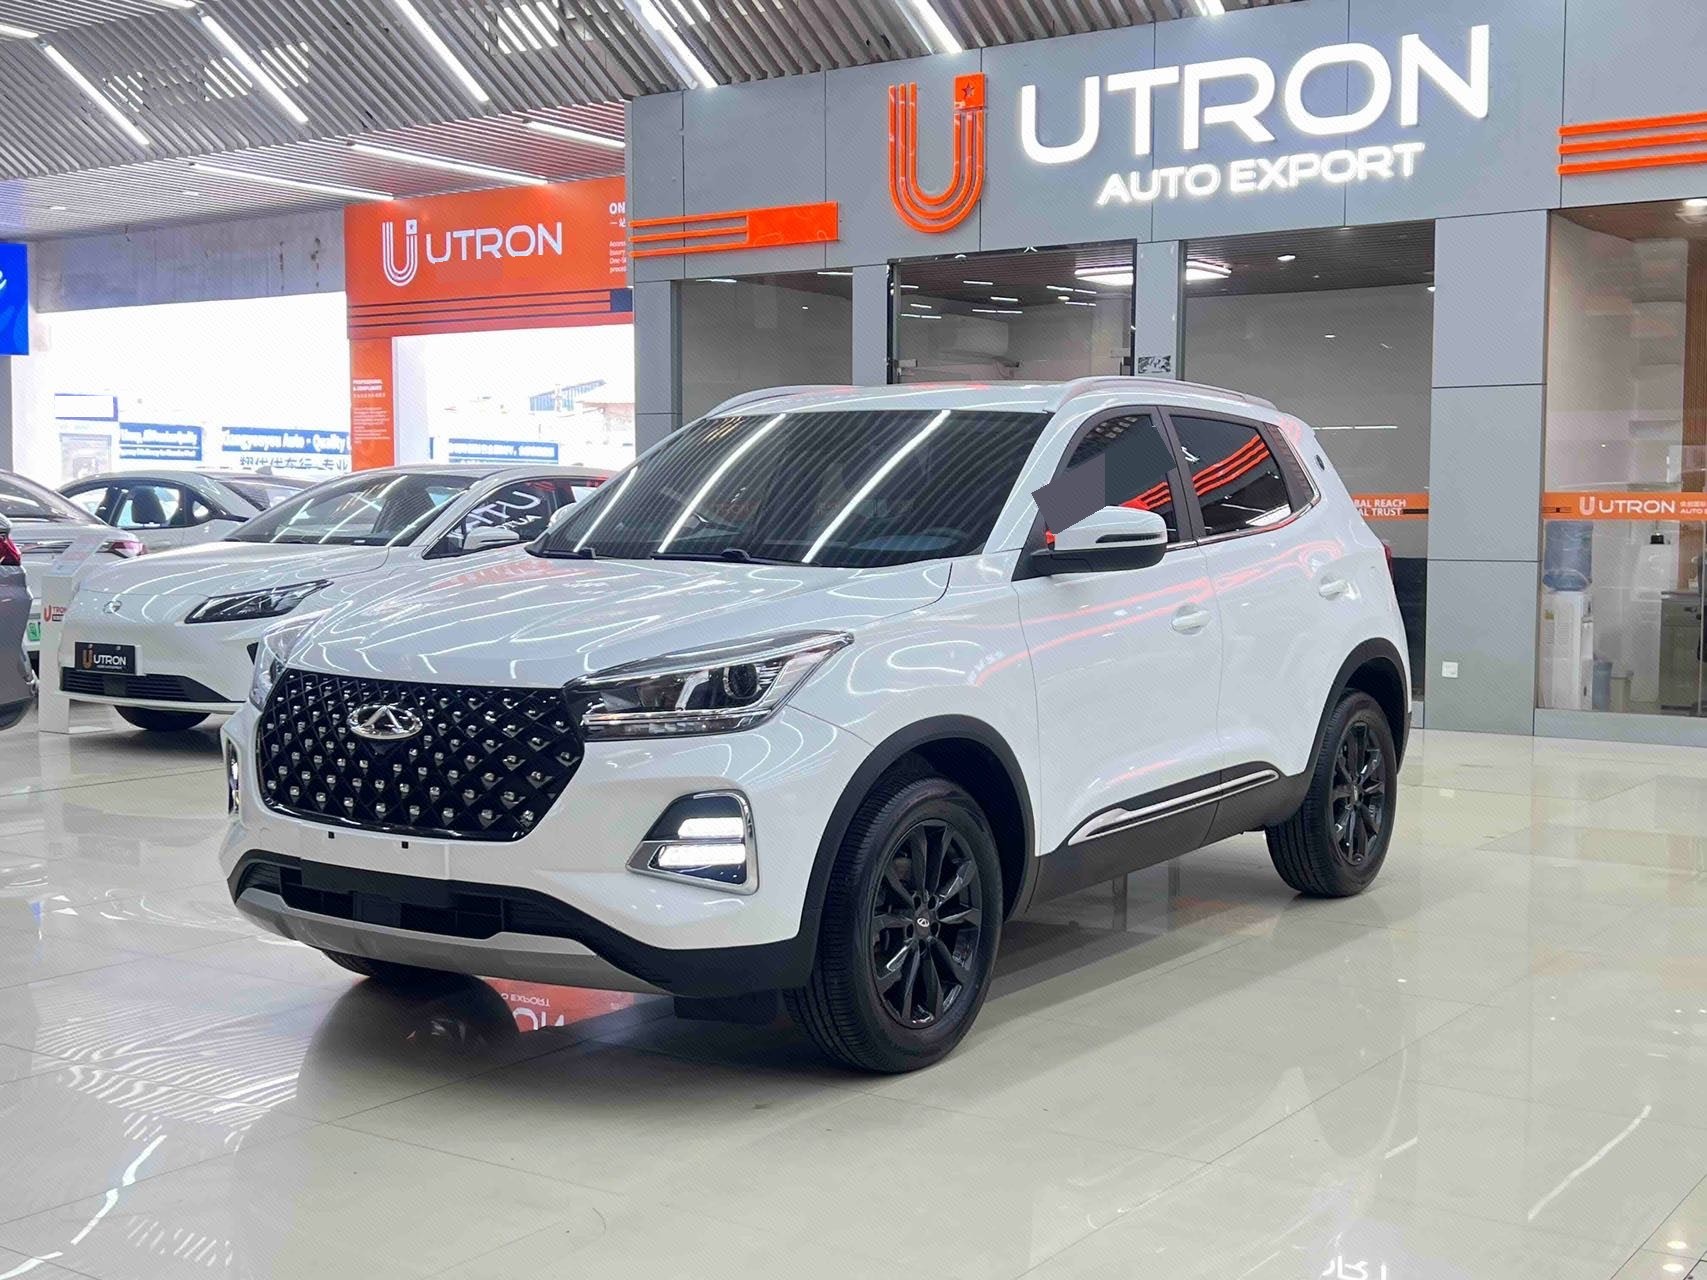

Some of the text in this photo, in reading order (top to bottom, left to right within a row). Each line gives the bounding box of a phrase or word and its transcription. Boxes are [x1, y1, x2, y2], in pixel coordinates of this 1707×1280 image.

[1020, 24, 1490, 163] UTRON
[1096, 142, 1426, 206] AUTO EXPORT
[609, 202, 626, 214] ON
[426, 222, 562, 264] UTRON
[1374, 499, 1406, 507] REACH
[1598, 499, 1676, 514] UTRON
[1372, 507, 1402, 516] TRUST
[93, 654, 126, 666] UTRON
